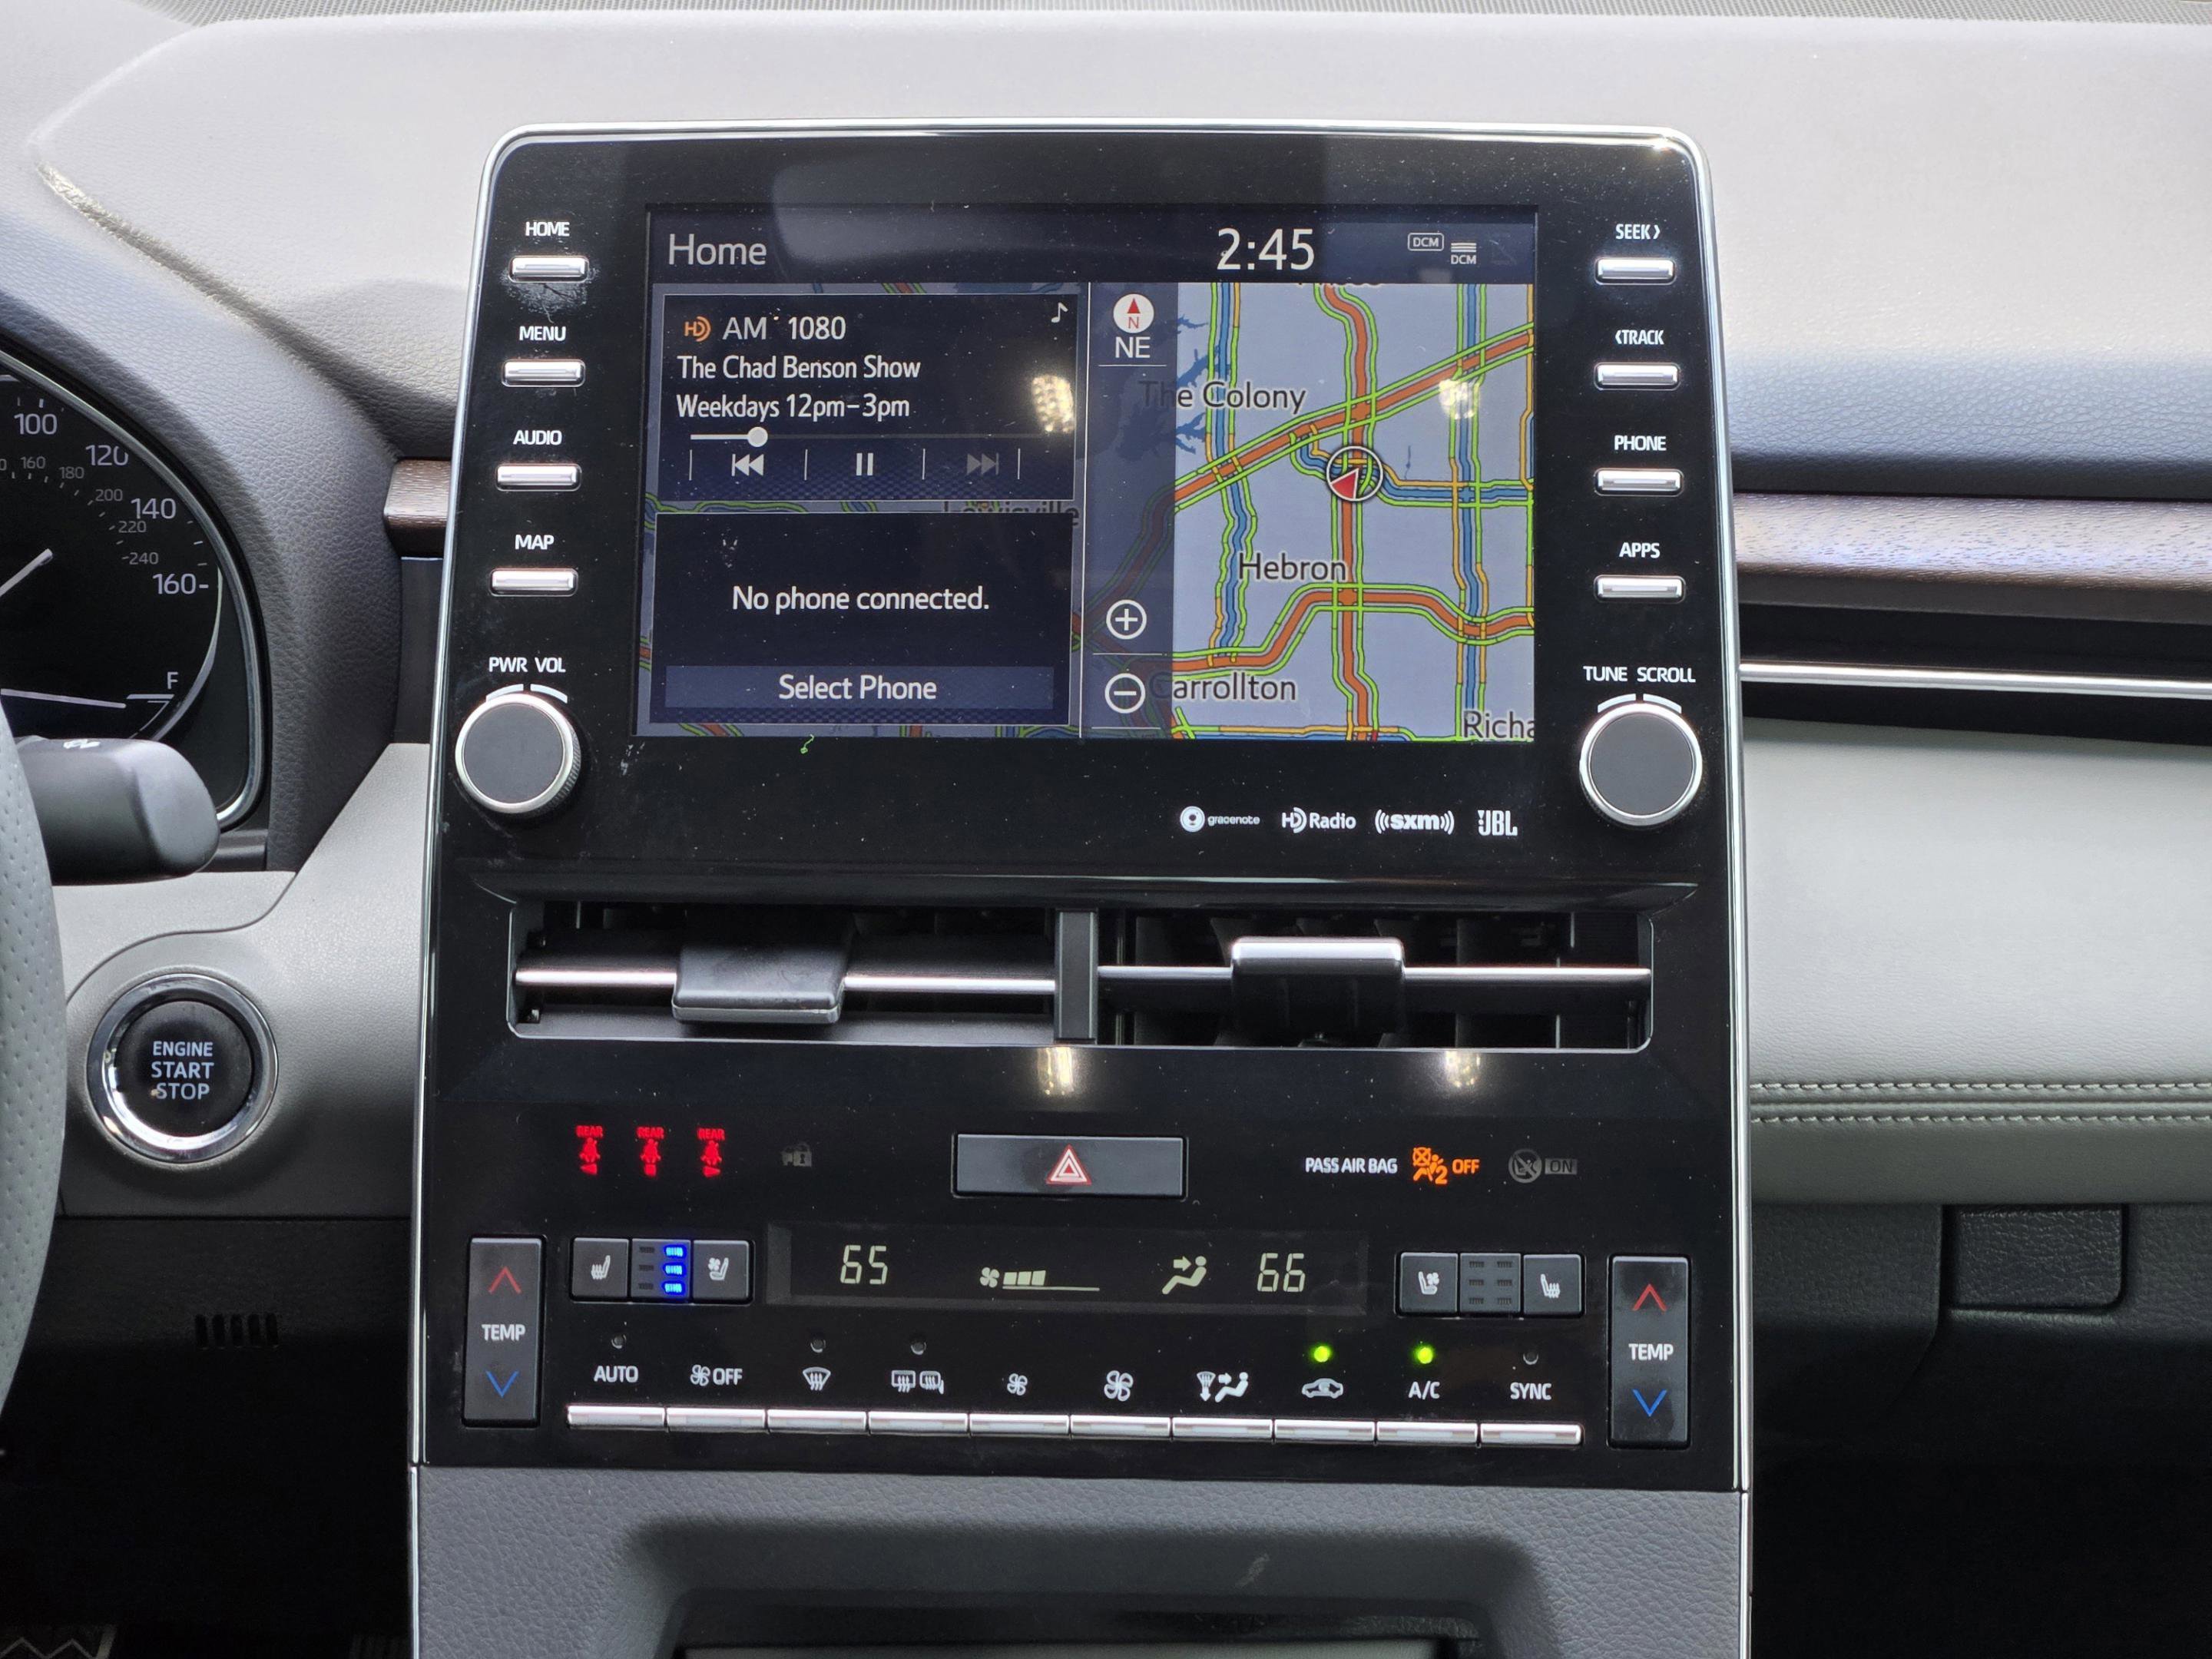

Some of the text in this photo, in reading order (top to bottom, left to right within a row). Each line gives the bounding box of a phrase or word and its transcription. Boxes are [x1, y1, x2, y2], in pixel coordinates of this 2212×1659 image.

[525, 221, 570, 237] HOME
[1615, 224, 1651, 240] SEEK
[668, 233, 767, 266] Home
[1217, 228, 1315, 270] 2:45
[1412, 237, 1439, 247] DCM
[1450, 254, 1477, 265] DCM
[722, 316, 767, 340] AM
[788, 316, 846, 340] 1080
[1128, 316, 1140, 329] N
[519, 326, 566, 342] MENU
[1621, 329, 1664, 345] TRACK
[1115, 336, 1151, 359] NE
[677, 355, 921, 379] The Chad Benson Show
[1203, 381, 1306, 415] Colony
[677, 394, 780, 422] Weekdays
[14, 413, 58, 435] 100
[513, 429, 562, 446] AUDIO
[1614, 435, 1667, 452] PHONE
[20, 456, 46, 469] 160
[85, 445, 129, 466] 120
[59, 466, 84, 479] 180
[94, 488, 123, 502] 200
[131, 498, 177, 519] 140
[118, 521, 147, 533] 220
[515, 535, 555, 550] MAP
[1620, 542, 1661, 558] APPS
[128, 551, 159, 565] 240
[1239, 553, 1347, 581] Hebron
[152, 573, 197, 594] 160
[733, 586, 990, 615] No phone connected.
[488, 657, 566, 673] PWR VOL
[167, 673, 177, 689] F
[1584, 667, 1696, 683] TUNE SCROLL
[778, 674, 937, 700] Select Phone
[1207, 815, 1260, 826] gracenote
[1309, 812, 1356, 830] Radio
[1478, 810, 1518, 836] JBL
[153, 1041, 214, 1057] ENGINE
[151, 1061, 214, 1079] START
[156, 1083, 210, 1100] STOP
[576, 1125, 604, 1138] REAR
[636, 1127, 664, 1139] REAR
[697, 1128, 725, 1141] REAR
[1305, 1157, 1398, 1174] PASS AIR BAG
[1452, 1159, 1480, 1174] OFF
[1549, 1159, 1575, 1174] ON
[840, 1245, 888, 1284] 65
[1257, 1253, 1306, 1293] 66
[482, 1324, 525, 1341] TEMP
[1629, 1343, 1674, 1361] TEMP
[594, 1366, 638, 1382] AUTO
[713, 1368, 743, 1386] OFF
[1408, 1382, 1441, 1399] A/C
[1510, 1383, 1551, 1401] SYNC
